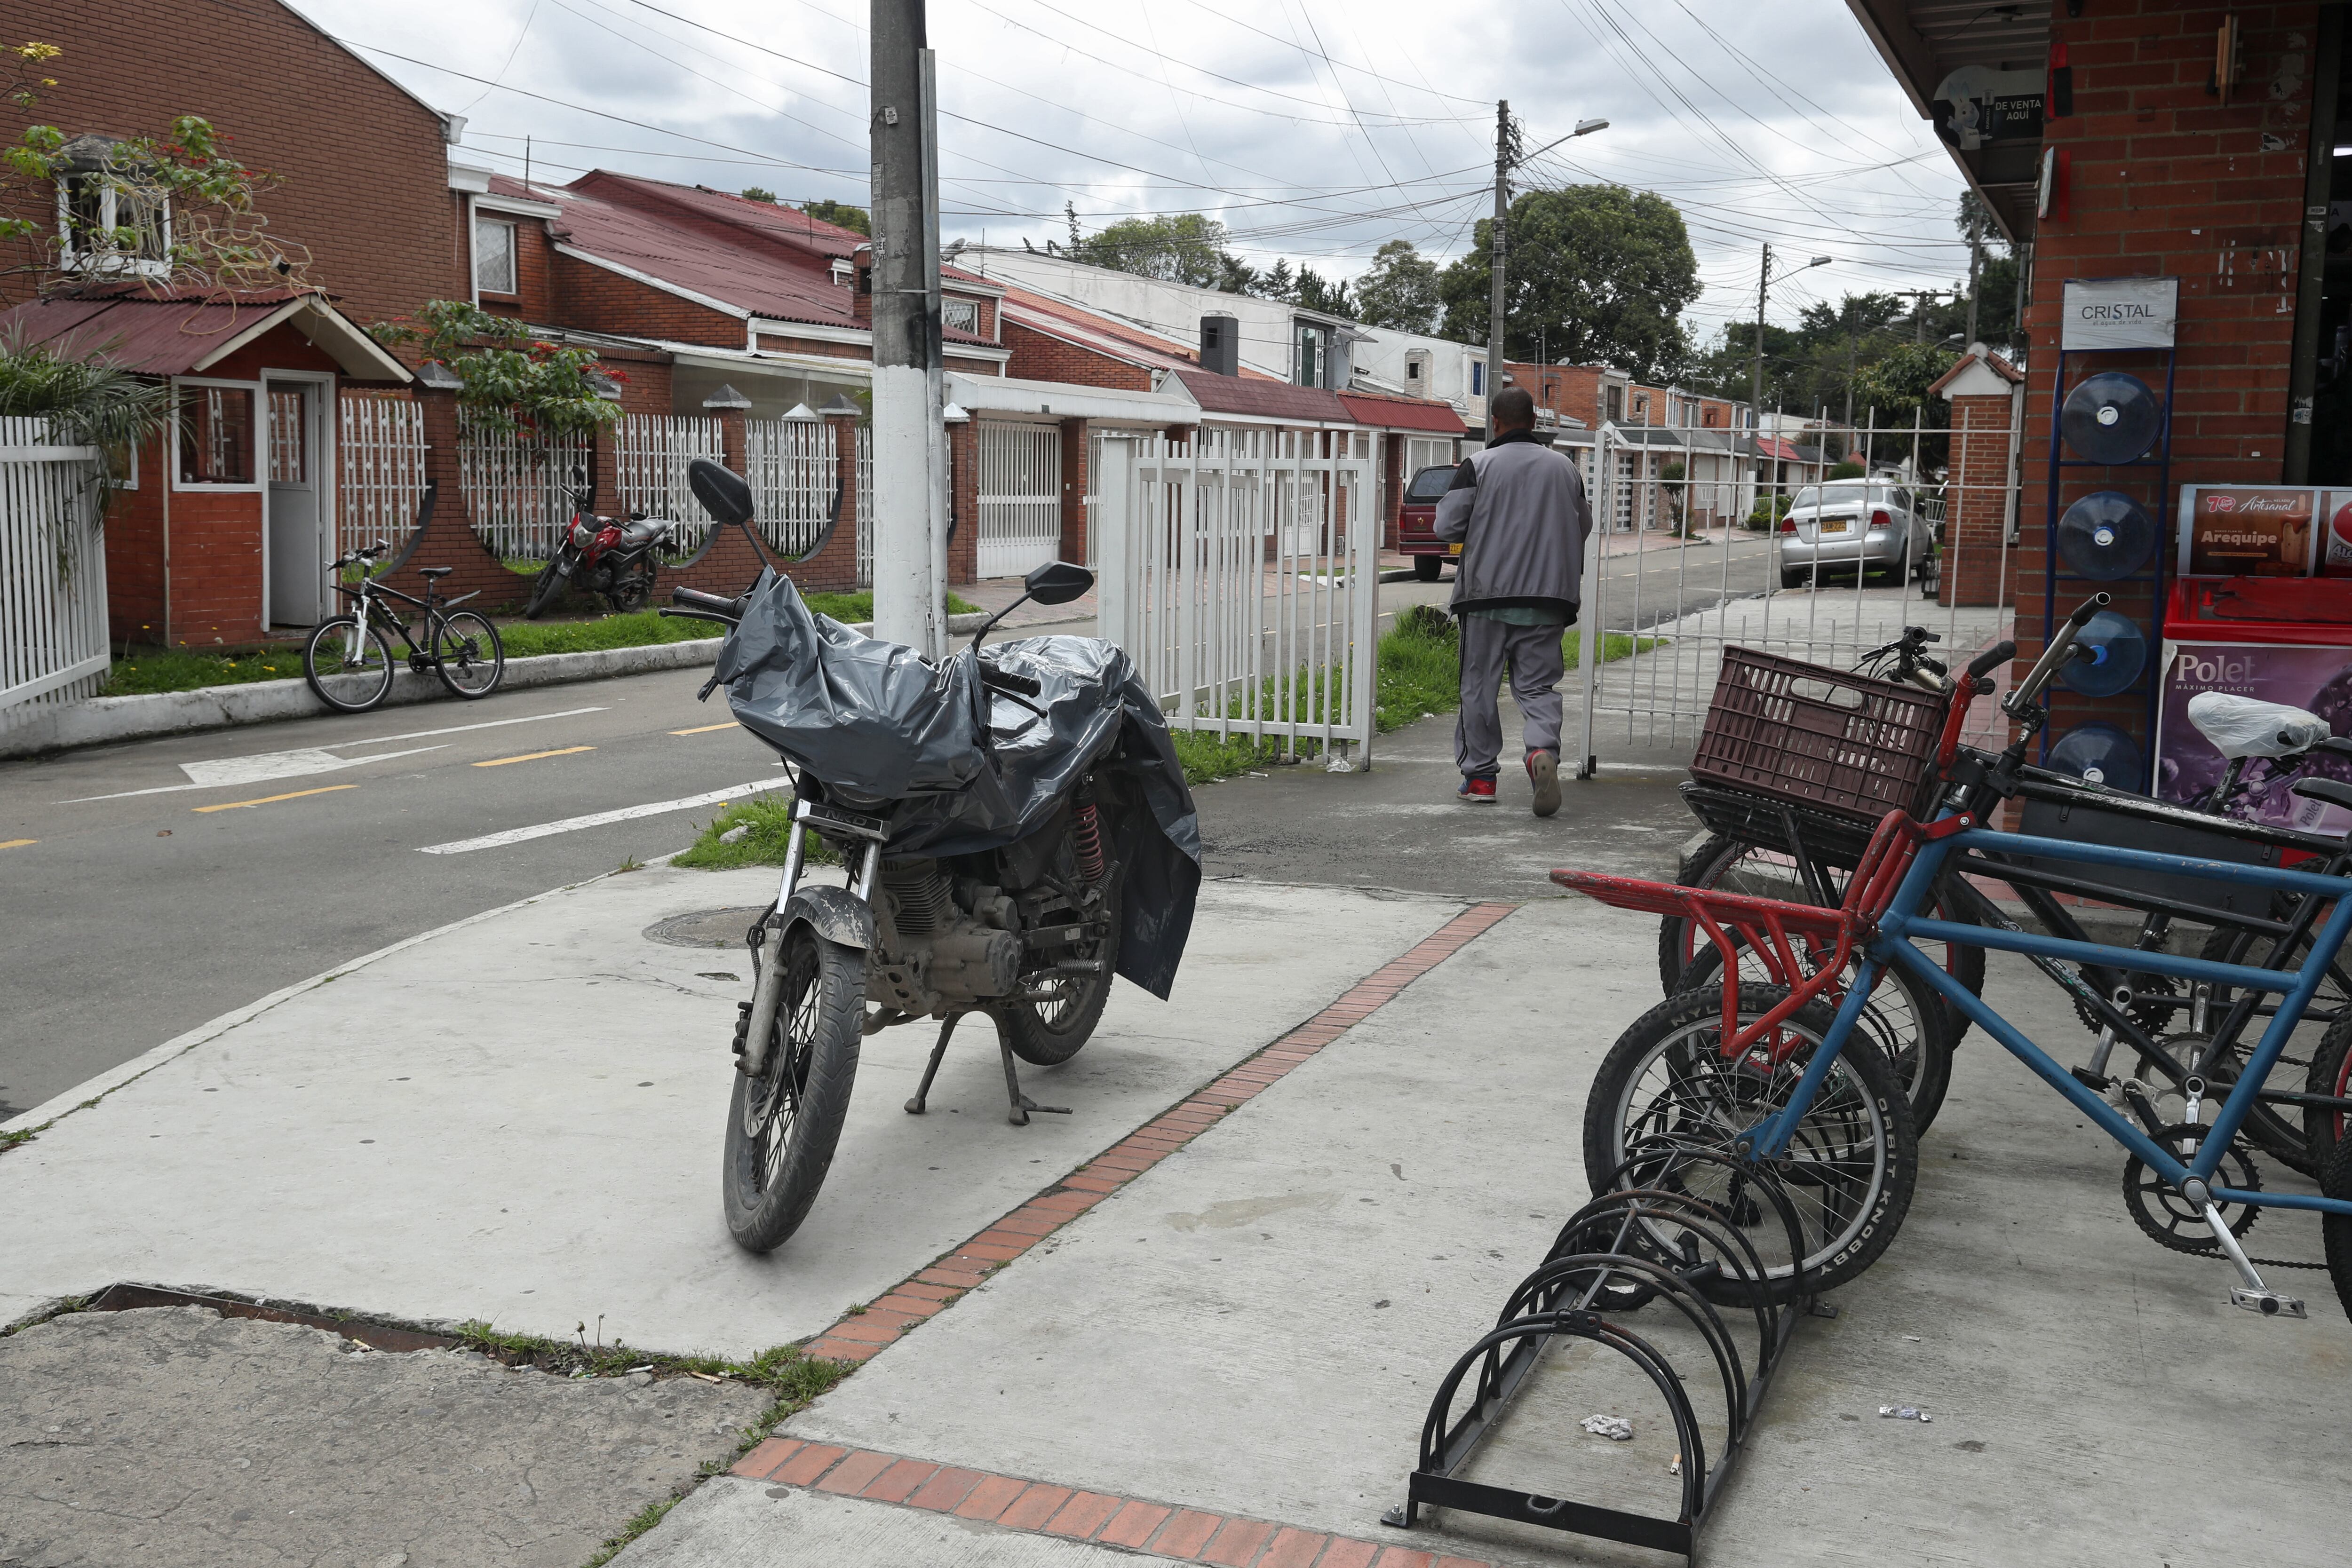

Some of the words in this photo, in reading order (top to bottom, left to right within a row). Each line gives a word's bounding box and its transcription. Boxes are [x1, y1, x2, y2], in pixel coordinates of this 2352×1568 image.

[2010, 100, 2042, 109] VENTA
[2006, 109, 2028, 120] AQUÍ
[2082, 304, 2155, 319] CRISTAL
[2238, 495, 2296, 513] Artesanal
[2201, 531, 2277, 546] Arequipe
[2176, 655, 2256, 683] Polet
[825, 809, 867, 826] NKD
[2299, 799, 2322, 826] Polet
[1670, 1001, 1756, 1027] NYLN
[1877, 1097, 1897, 1178] ORBIT
[1820, 1189, 1891, 1276] KNOBBY
